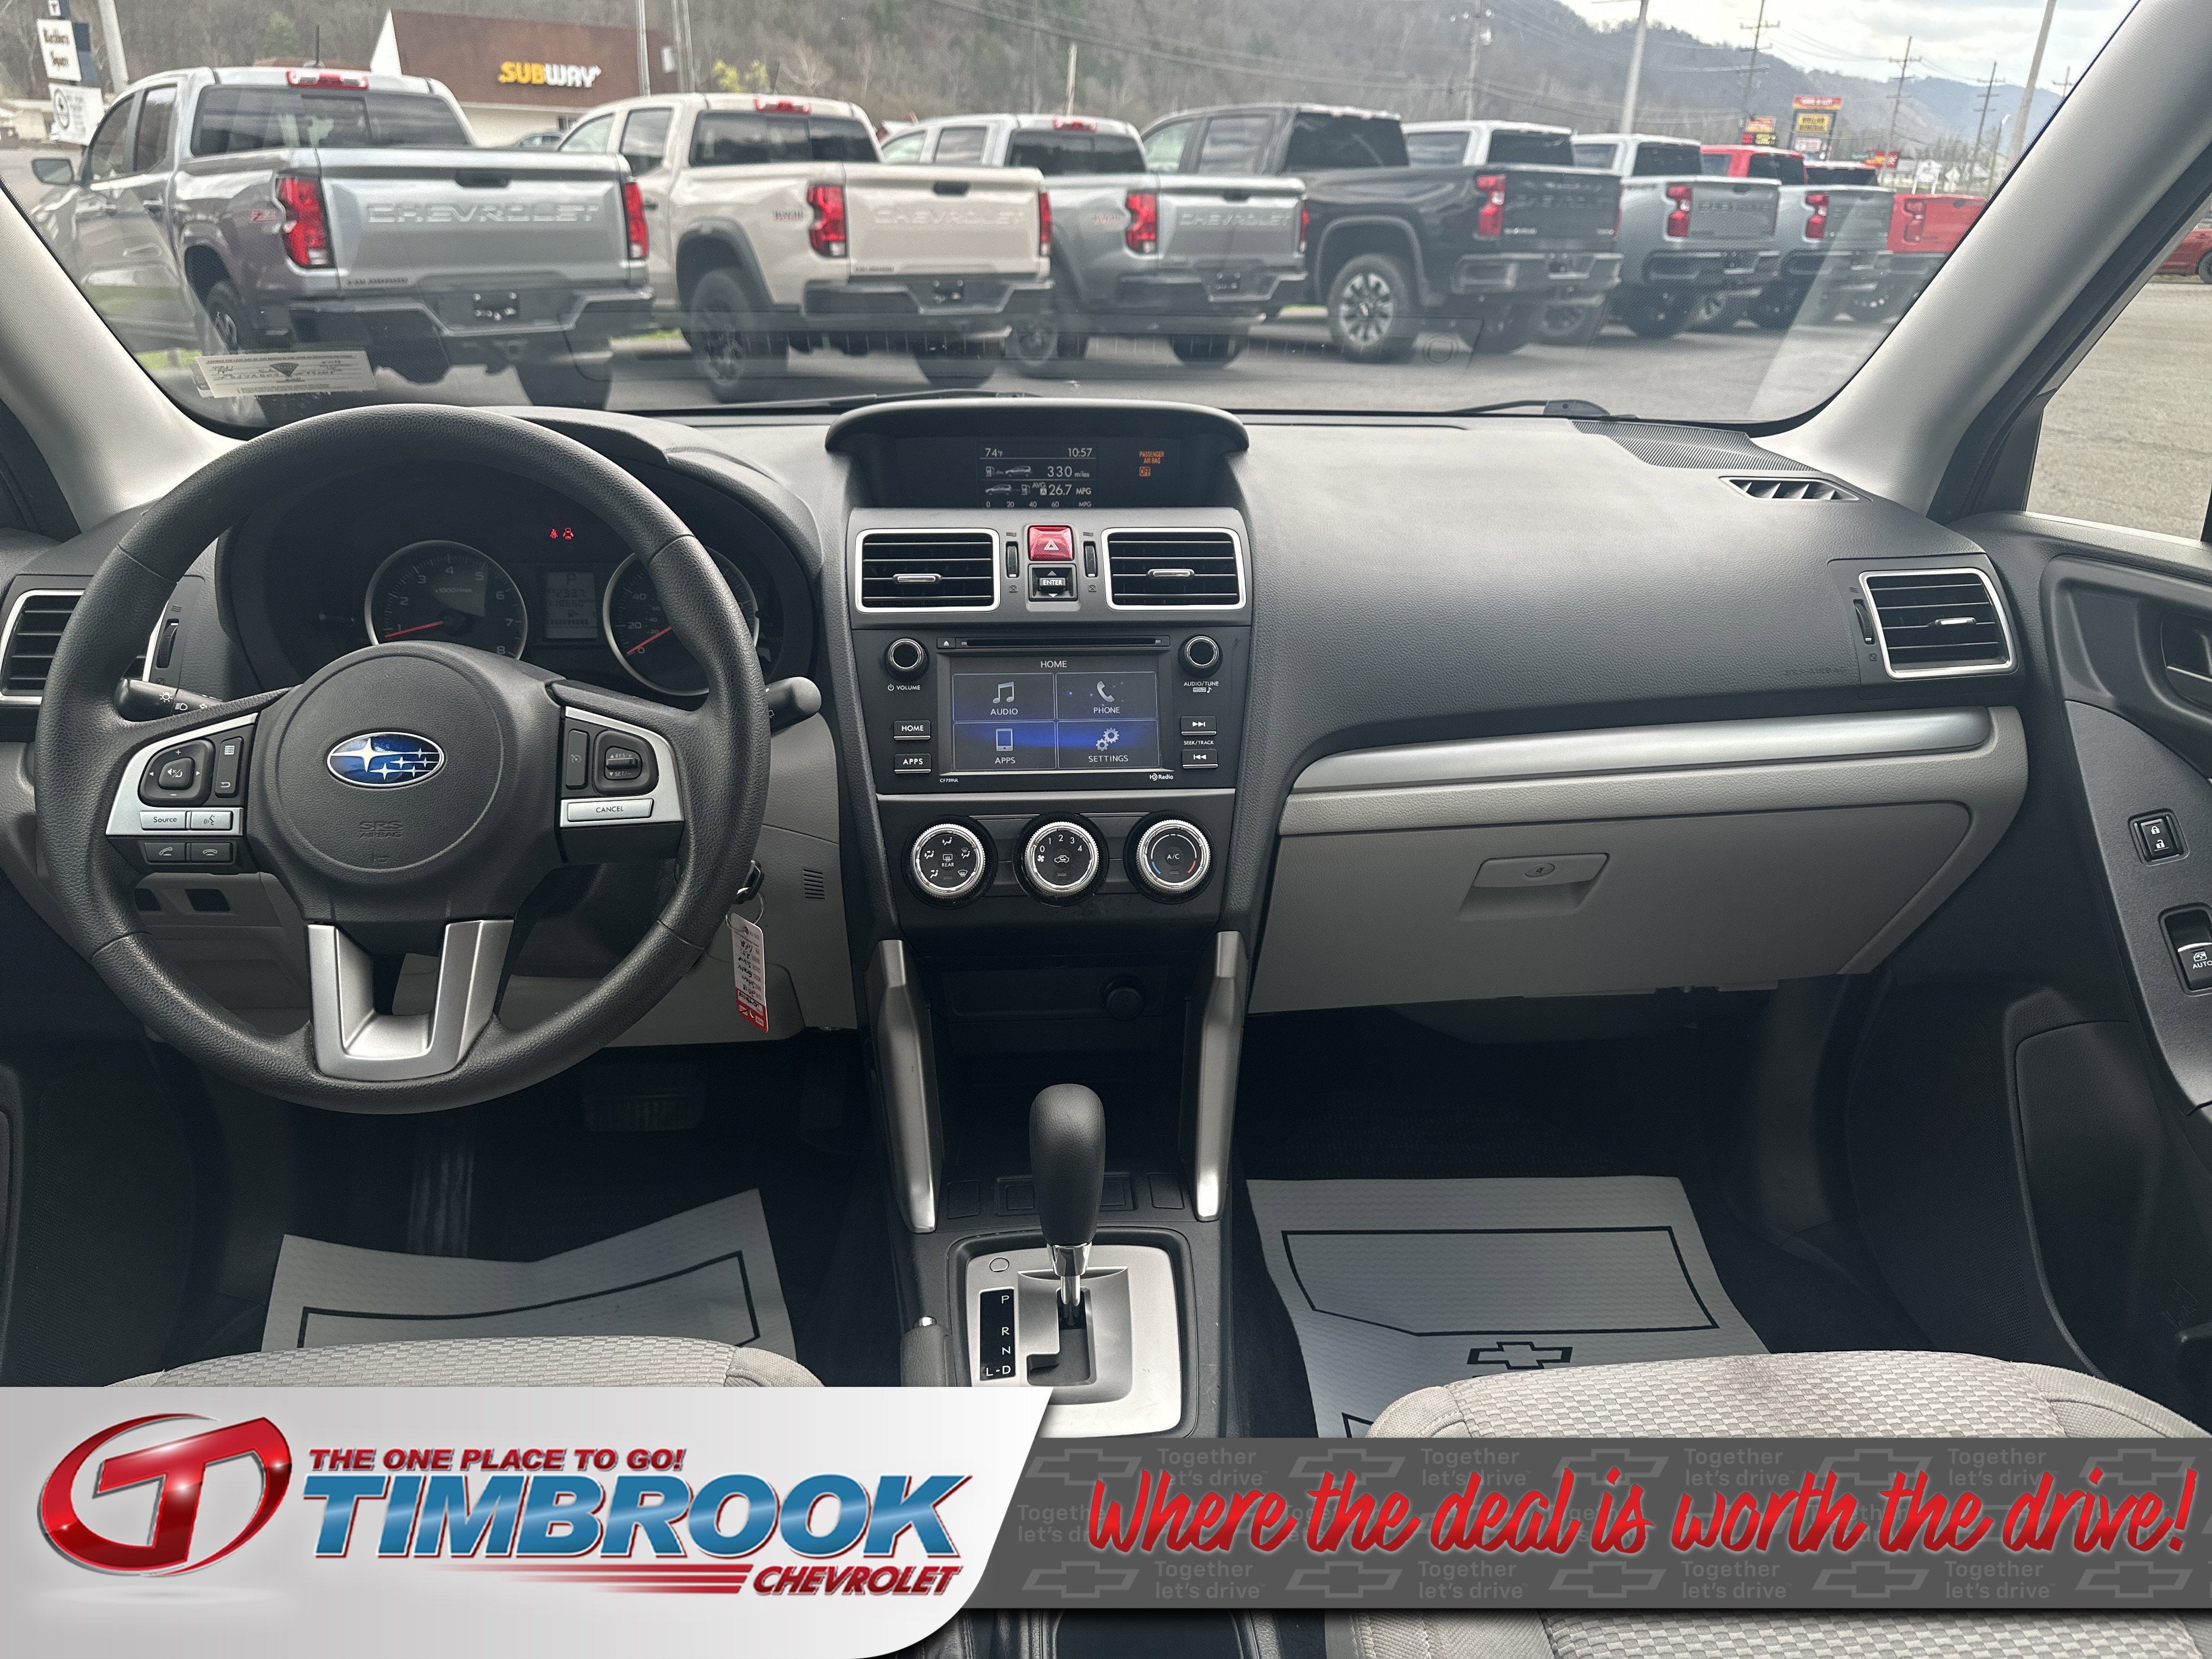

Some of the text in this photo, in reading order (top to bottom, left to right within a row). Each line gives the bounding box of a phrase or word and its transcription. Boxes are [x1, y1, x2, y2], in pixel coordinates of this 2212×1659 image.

[499, 61, 601, 88] SUBWAY
[368, 202, 599, 223] CHEVROLET
[1068, 447, 1093, 458] 10:57
[1047, 466, 1073, 478] 330
[1140, 467, 1150, 476] OFF
[1048, 484, 1073, 495] 26.7
[445, 566, 454, 575] 4
[417, 575, 426, 584] 3
[475, 571, 484, 581] 5
[496, 591, 505, 600] 6
[632, 592, 647, 601] 40
[400, 596, 410, 605] 2
[505, 618, 514, 627] 7
[627, 621, 642, 629] 20
[496, 645, 506, 655] 8
[359, 822, 404, 831] SRS
[2192, 961, 2212, 969] AUTO
[1001, 1295, 1011, 1304] P
[1001, 1327, 1011, 1336] R
[1002, 1346, 1011, 1356] N
